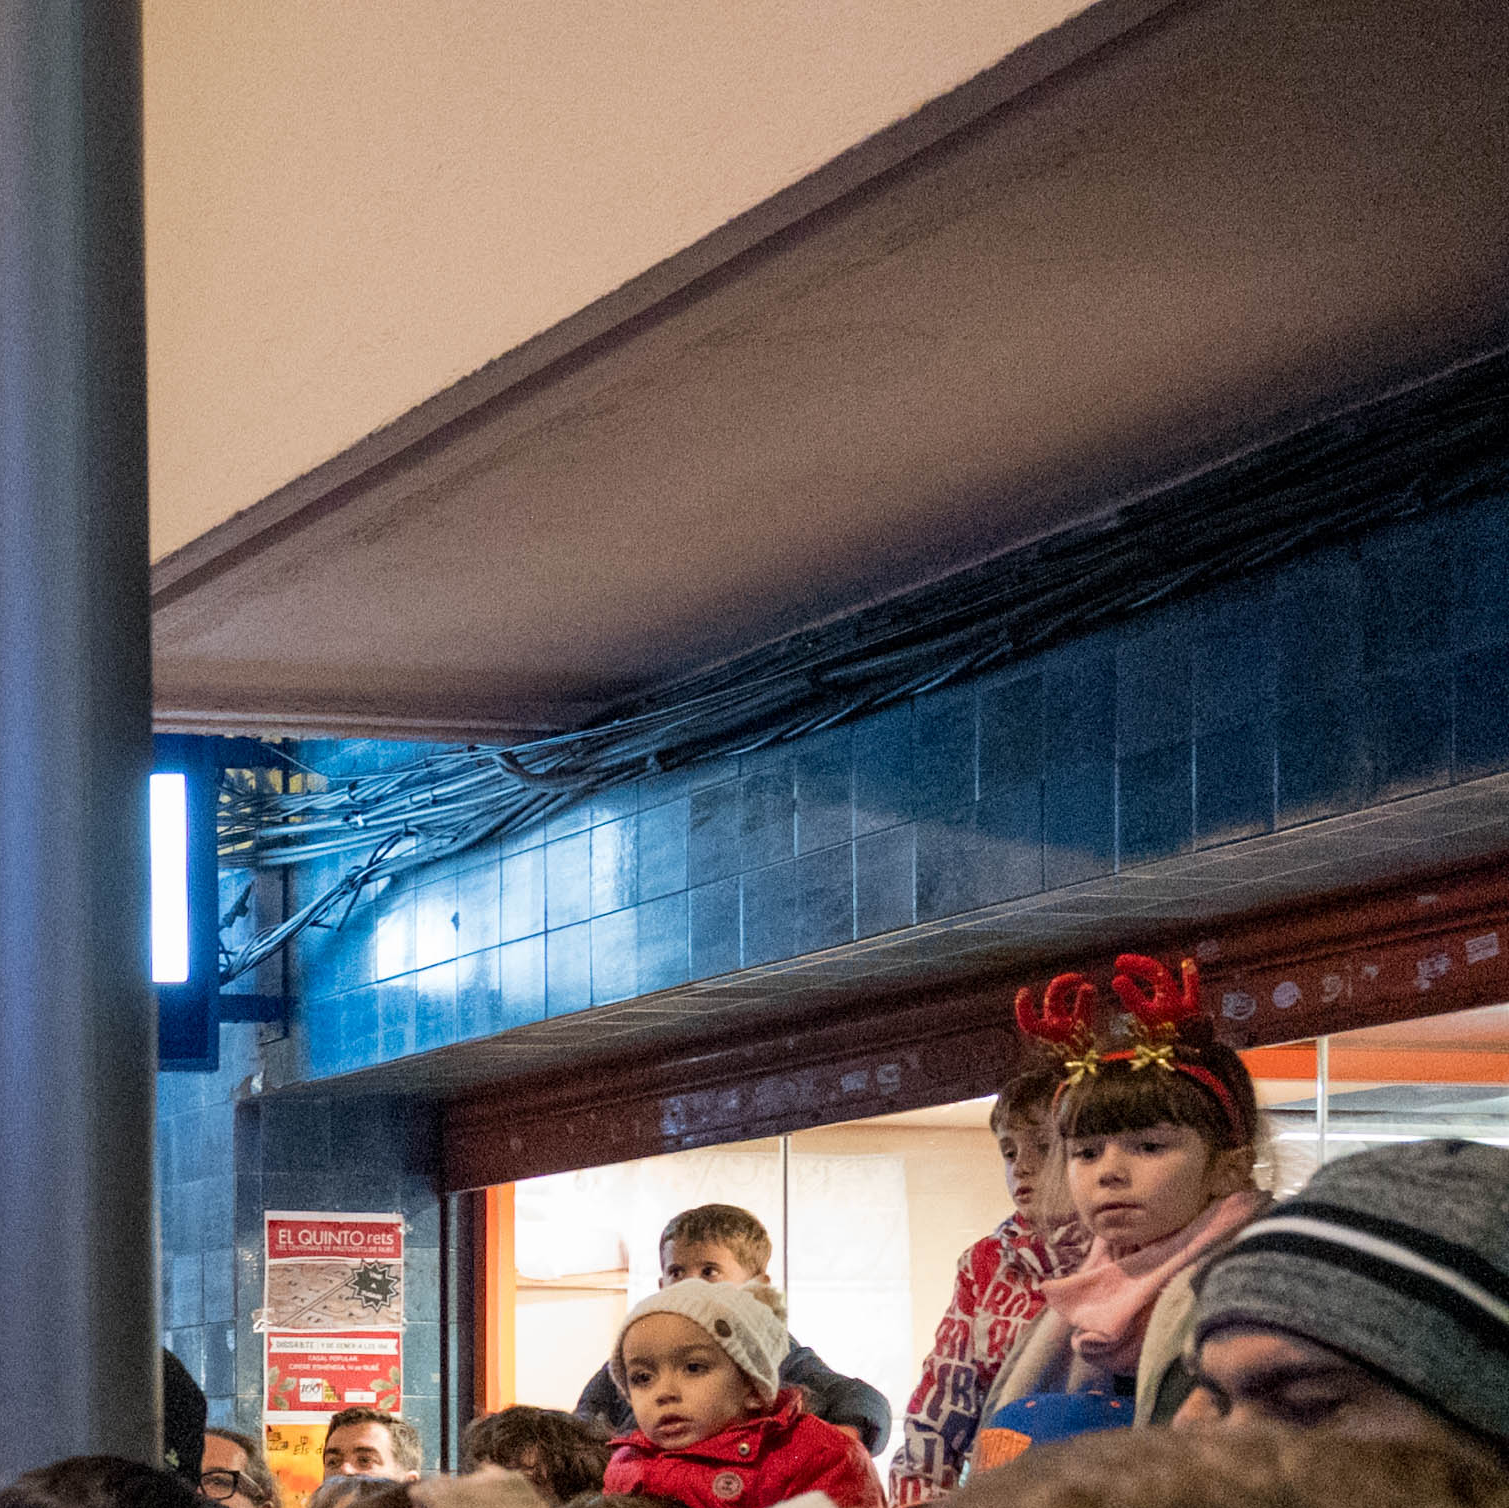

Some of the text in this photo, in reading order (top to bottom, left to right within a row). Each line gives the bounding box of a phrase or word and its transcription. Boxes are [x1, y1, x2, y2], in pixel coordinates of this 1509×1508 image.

[278, 1228, 395, 1246] EL QUINTO rets
